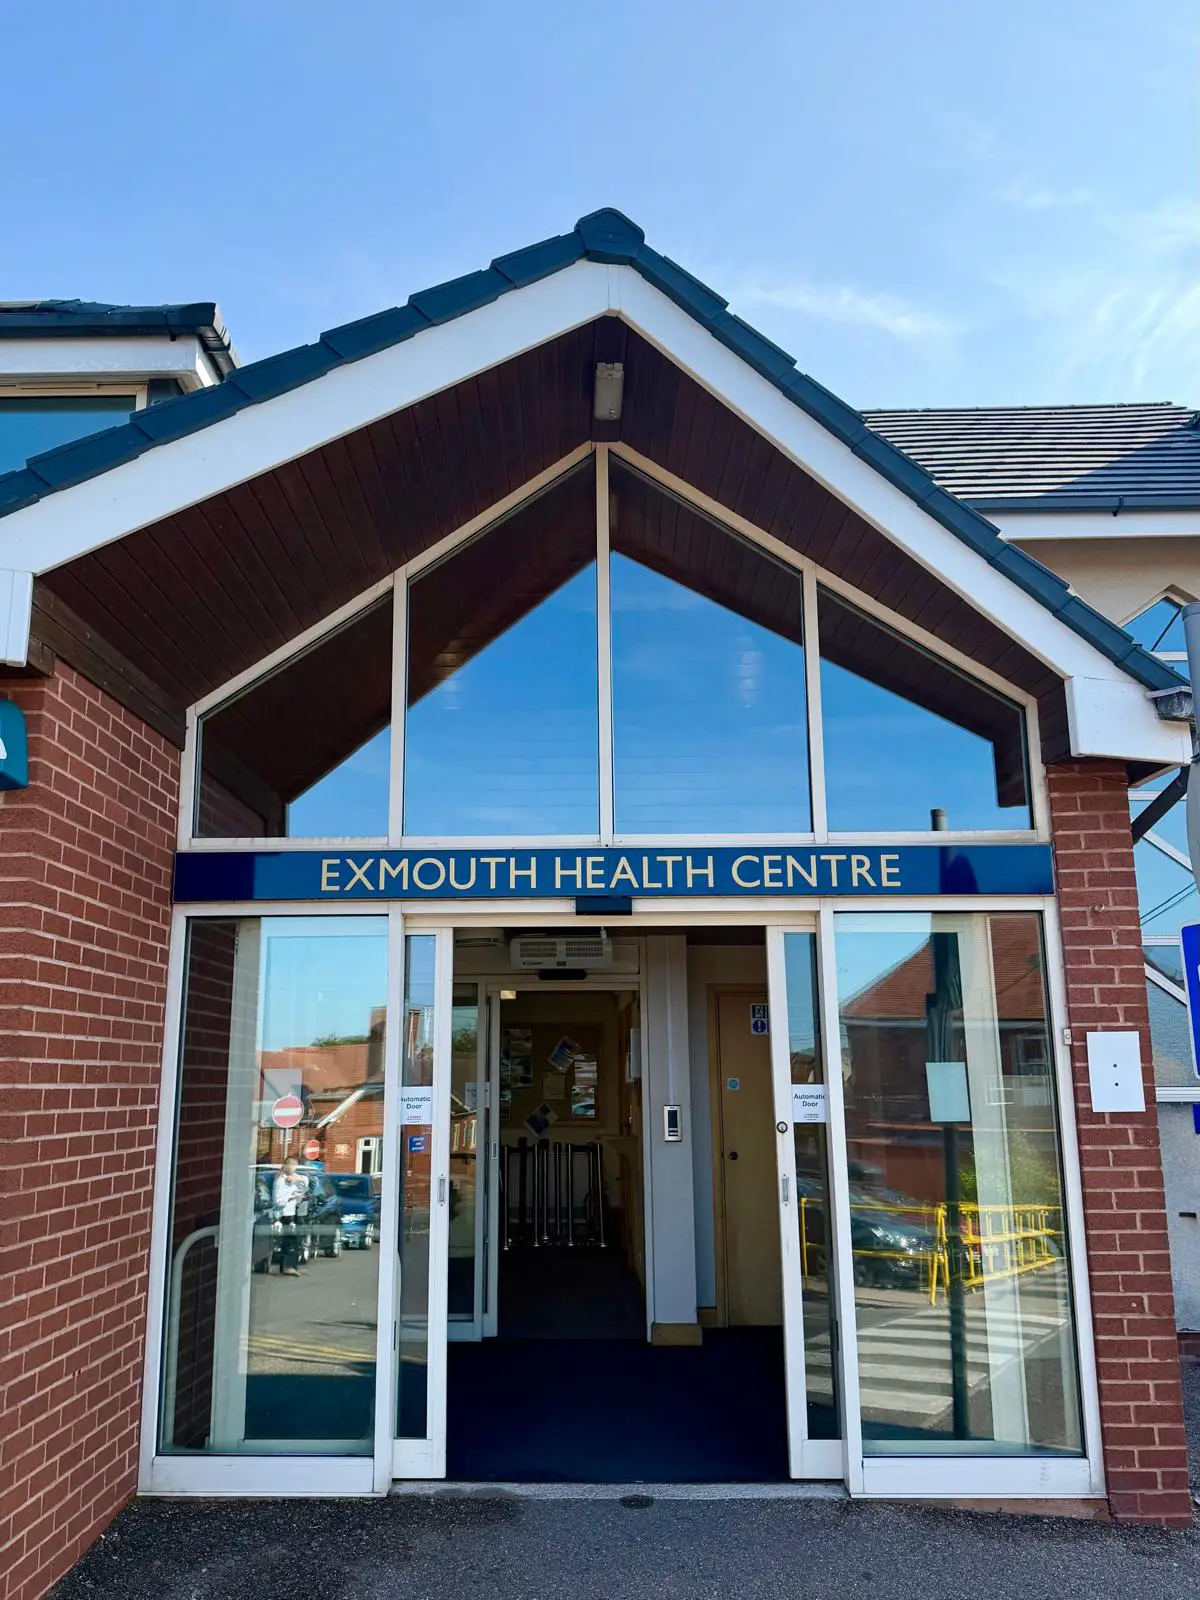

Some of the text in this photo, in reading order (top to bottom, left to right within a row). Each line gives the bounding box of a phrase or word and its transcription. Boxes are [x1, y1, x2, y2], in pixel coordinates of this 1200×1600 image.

[321, 854, 901, 891] EXMOUTH HEALTH CENTRE
